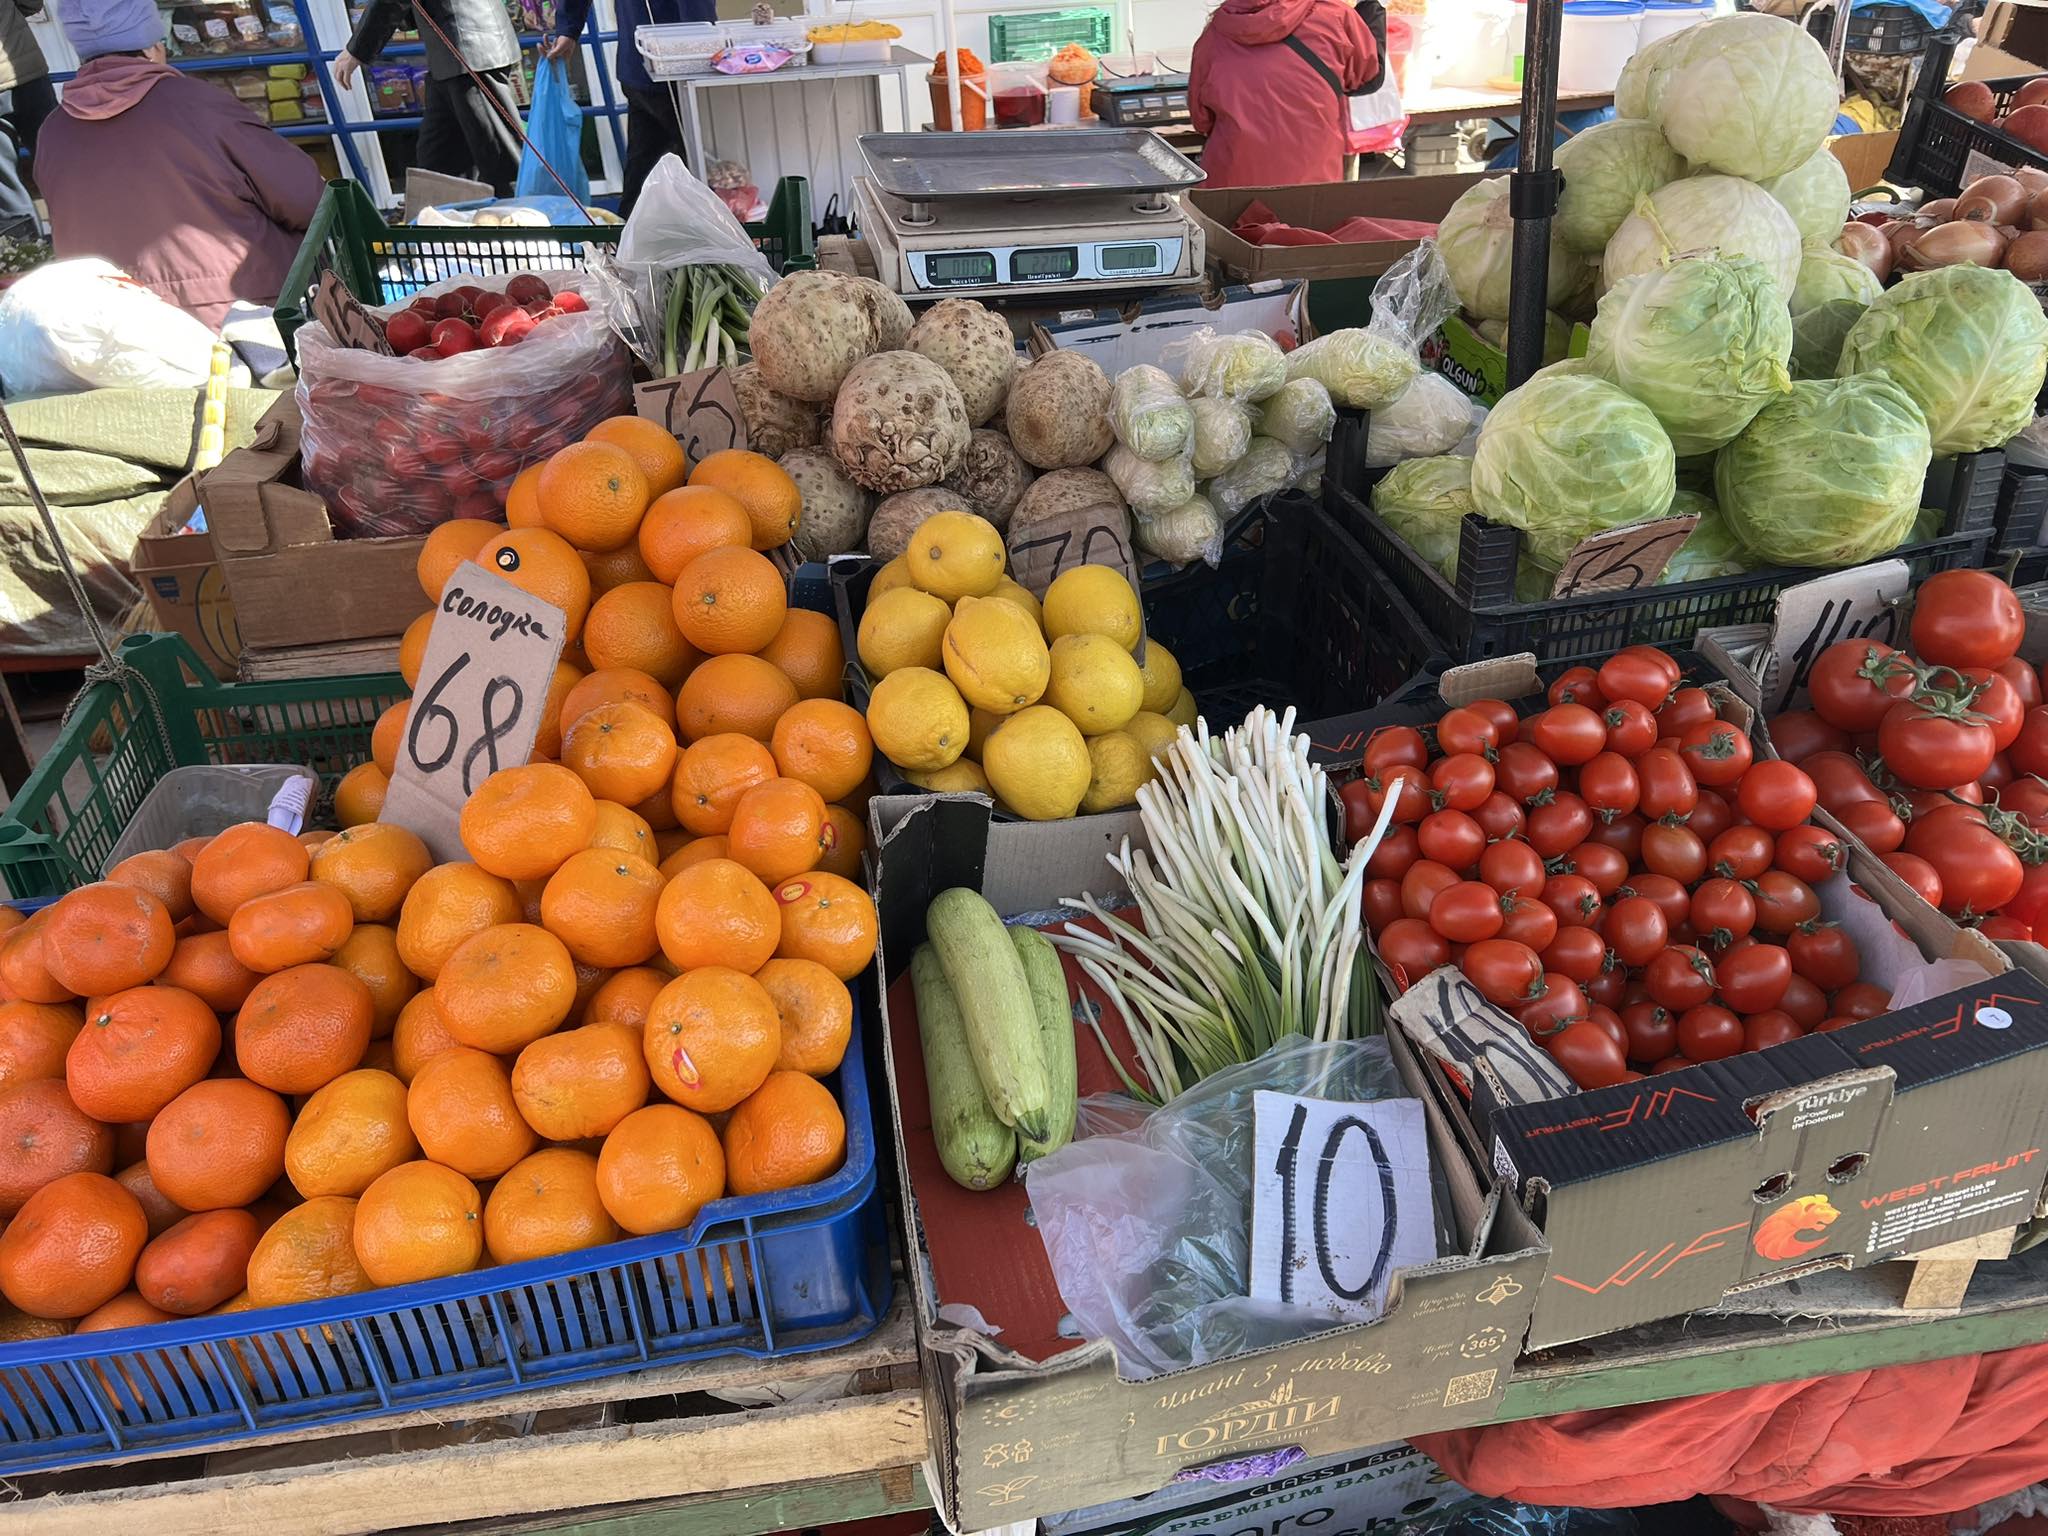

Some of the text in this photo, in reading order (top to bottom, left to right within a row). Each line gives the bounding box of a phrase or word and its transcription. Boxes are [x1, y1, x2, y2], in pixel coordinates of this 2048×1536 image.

[1442, 357, 1478, 393] OLGUN
[408, 652, 524, 798] 68
[1796, 1086, 1868, 1112] Türkiye
[1860, 1176, 1950, 1210] WEST
[1951, 1148, 2041, 1184] FRUIT
[1274, 1102, 1398, 1304] 10
[1469, 1335, 1498, 1351] 365
[1249, 1466, 1335, 1497] CLASS
[1168, 1484, 1326, 1533] PREMIUM
